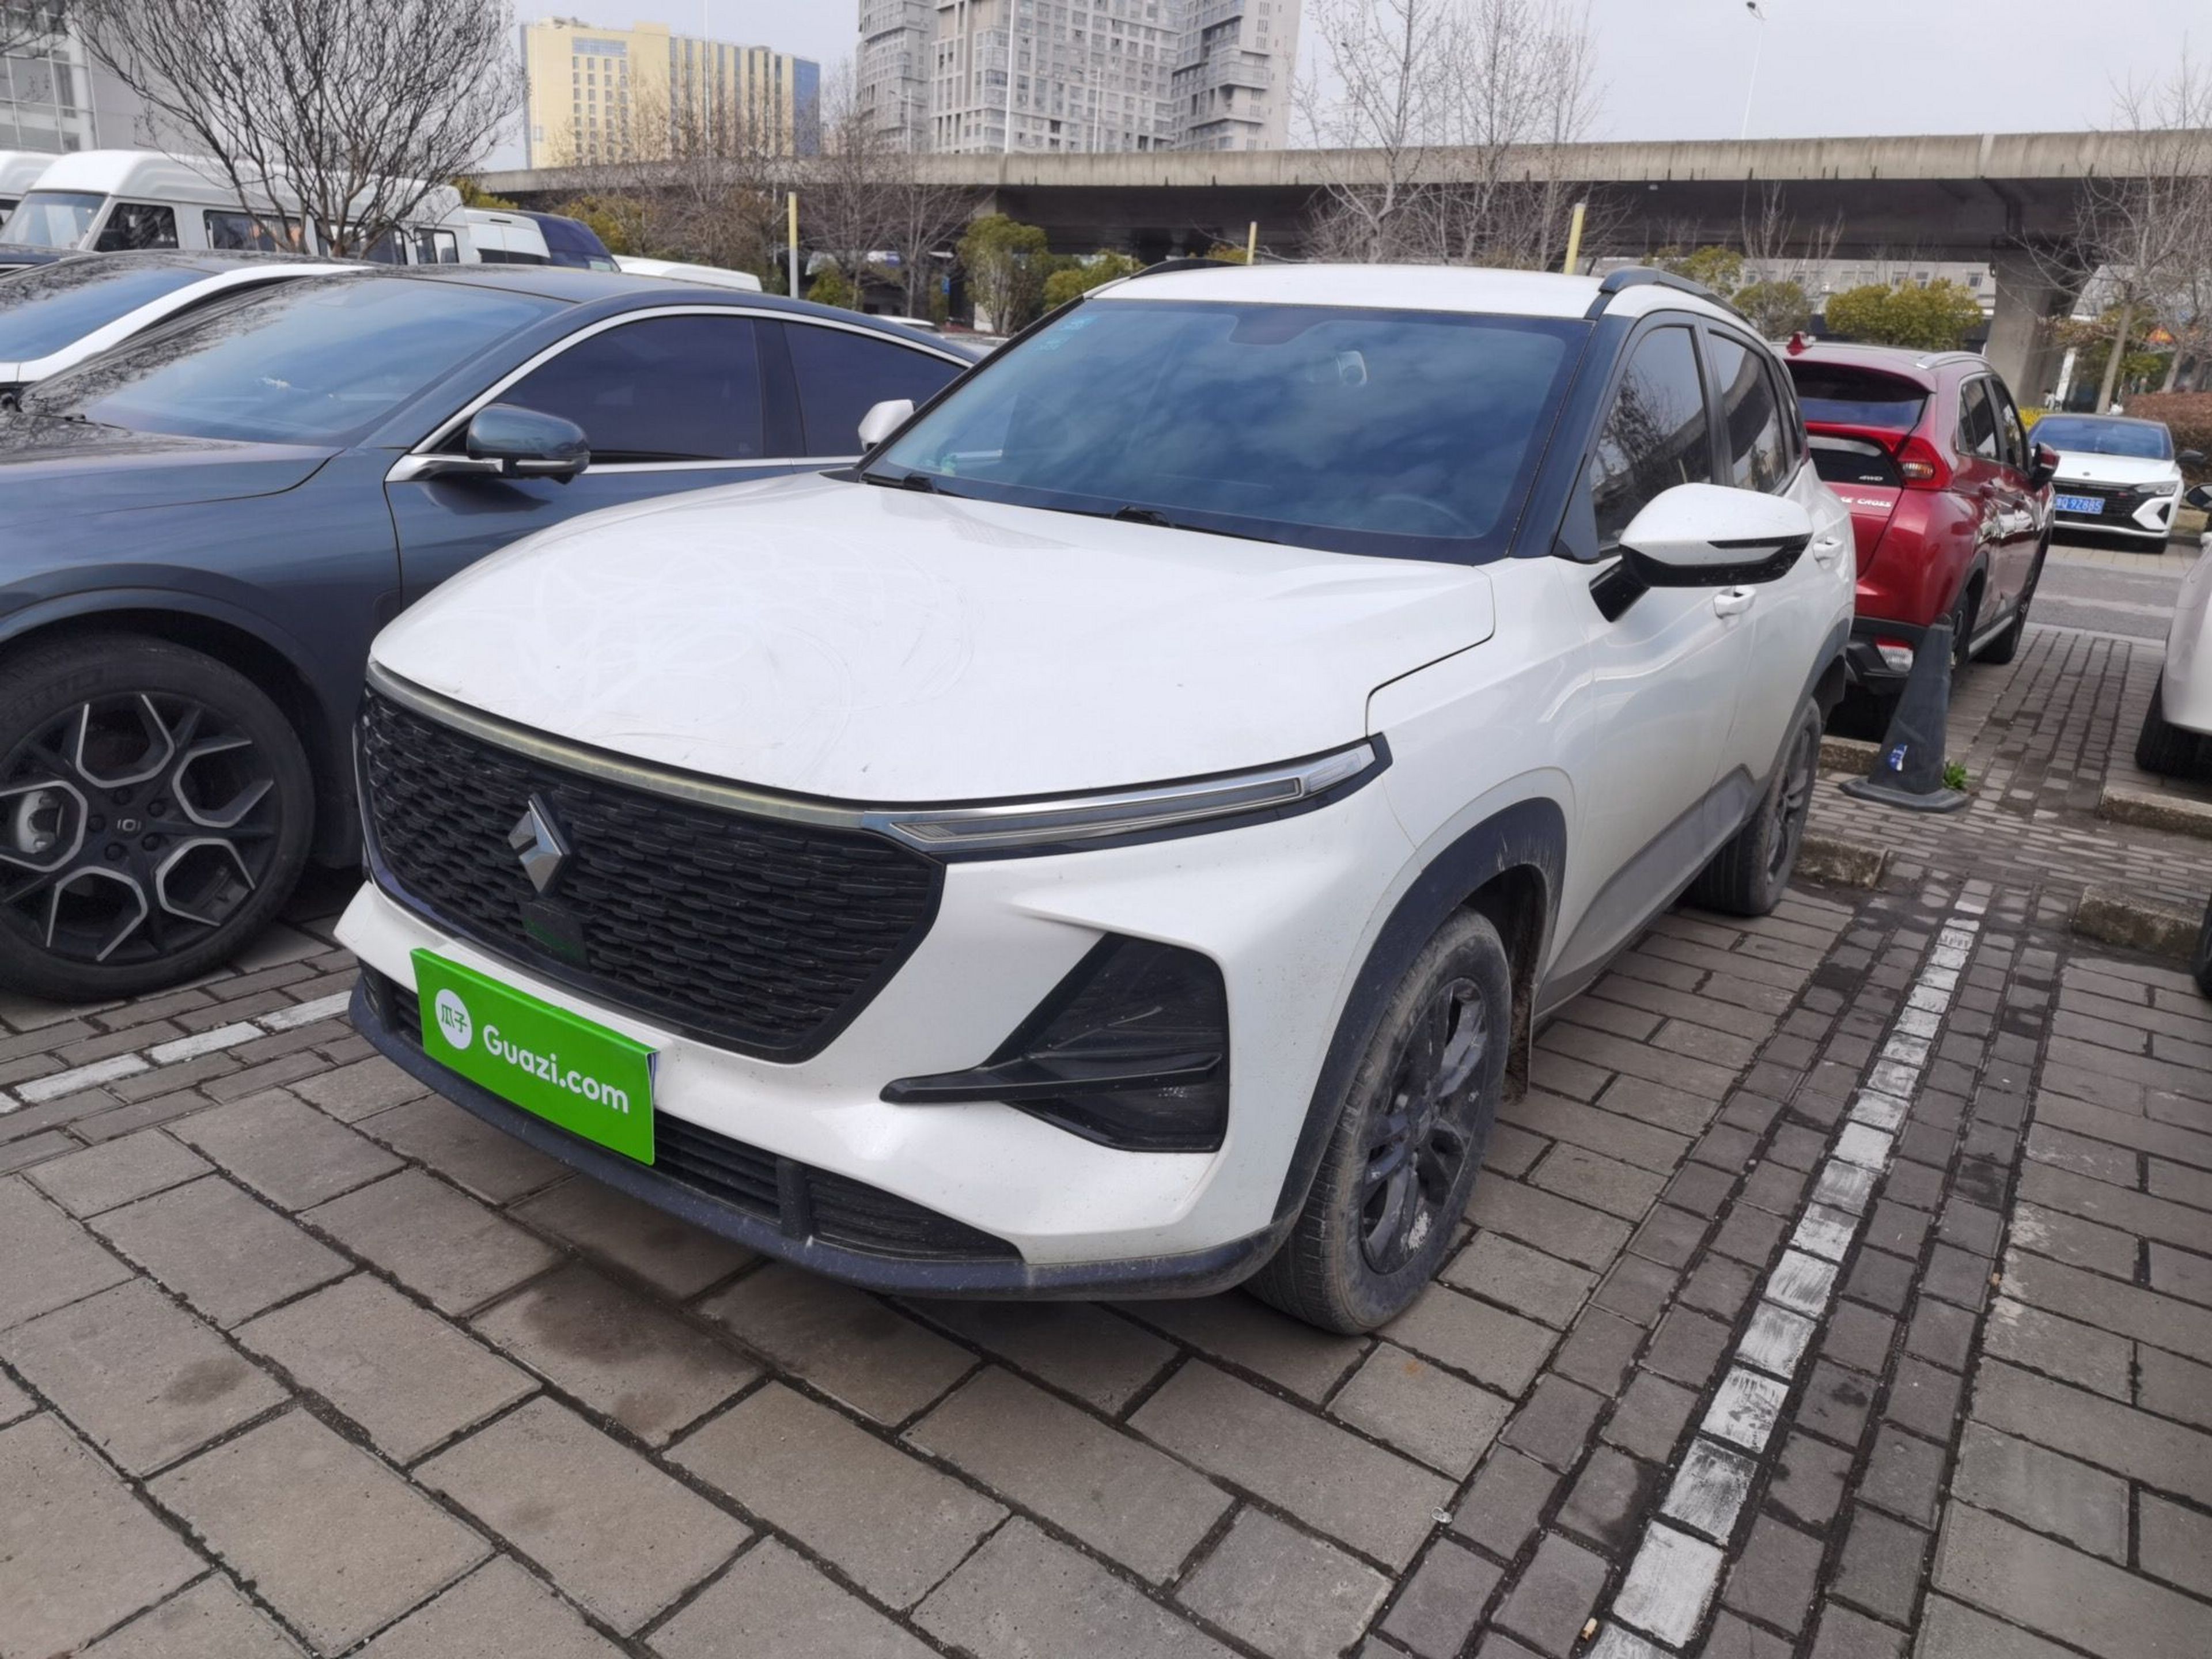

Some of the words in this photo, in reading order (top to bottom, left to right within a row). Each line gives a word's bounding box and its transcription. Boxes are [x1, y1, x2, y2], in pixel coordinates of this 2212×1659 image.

[1857, 498, 1892, 507] CROSS
[441, 1003, 467, 1033] 瓜子
[483, 1024, 629, 1114] Guazi.com
